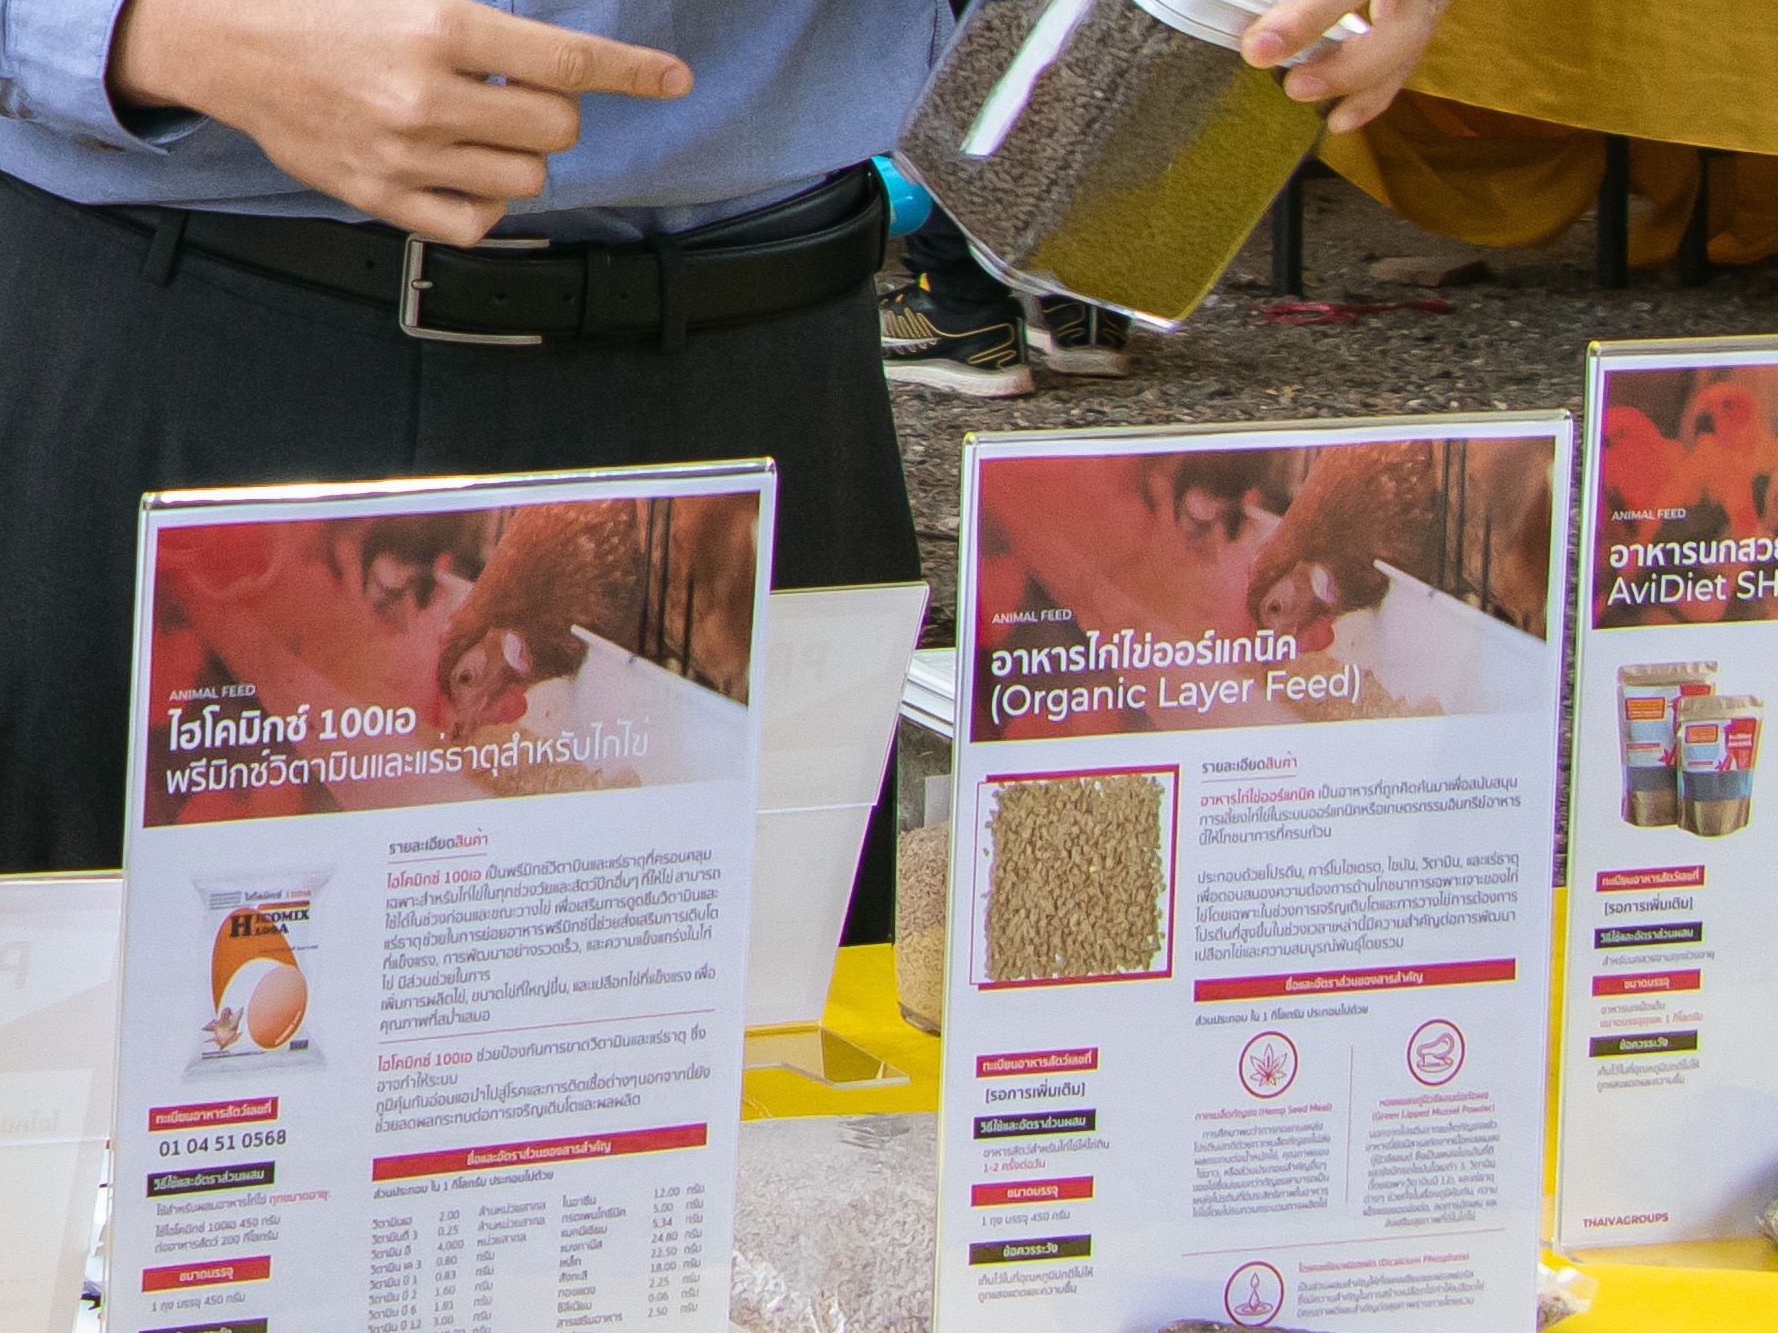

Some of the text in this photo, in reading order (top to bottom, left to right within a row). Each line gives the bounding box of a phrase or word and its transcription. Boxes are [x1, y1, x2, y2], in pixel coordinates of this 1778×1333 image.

[1611, 508, 1686, 521] ANIMAL FEED
[1609, 536, 1778, 568] อาหารนกสว
[1607, 572, 1727, 606] AviDiet
[992, 608, 1072, 625] ANIMAL FEED
[991, 629, 1297, 677] อาหารไก่ไข่ออร์แกนิค
[168, 682, 257, 702] ANIMAL FEED
[991, 663, 1362, 725] (Organic Layer Feed)
[167, 703, 417, 752] ไฮโคมิกซ์ 100เอ
[165, 718, 650, 795] พรีมิกซ์วิตามินและแร่ธาตุสำหรับไก่ไข่
[159, 1129, 286, 1157] 01 04 51 0568
[1583, 1212, 1669, 1228] THAIVAGROUPS
